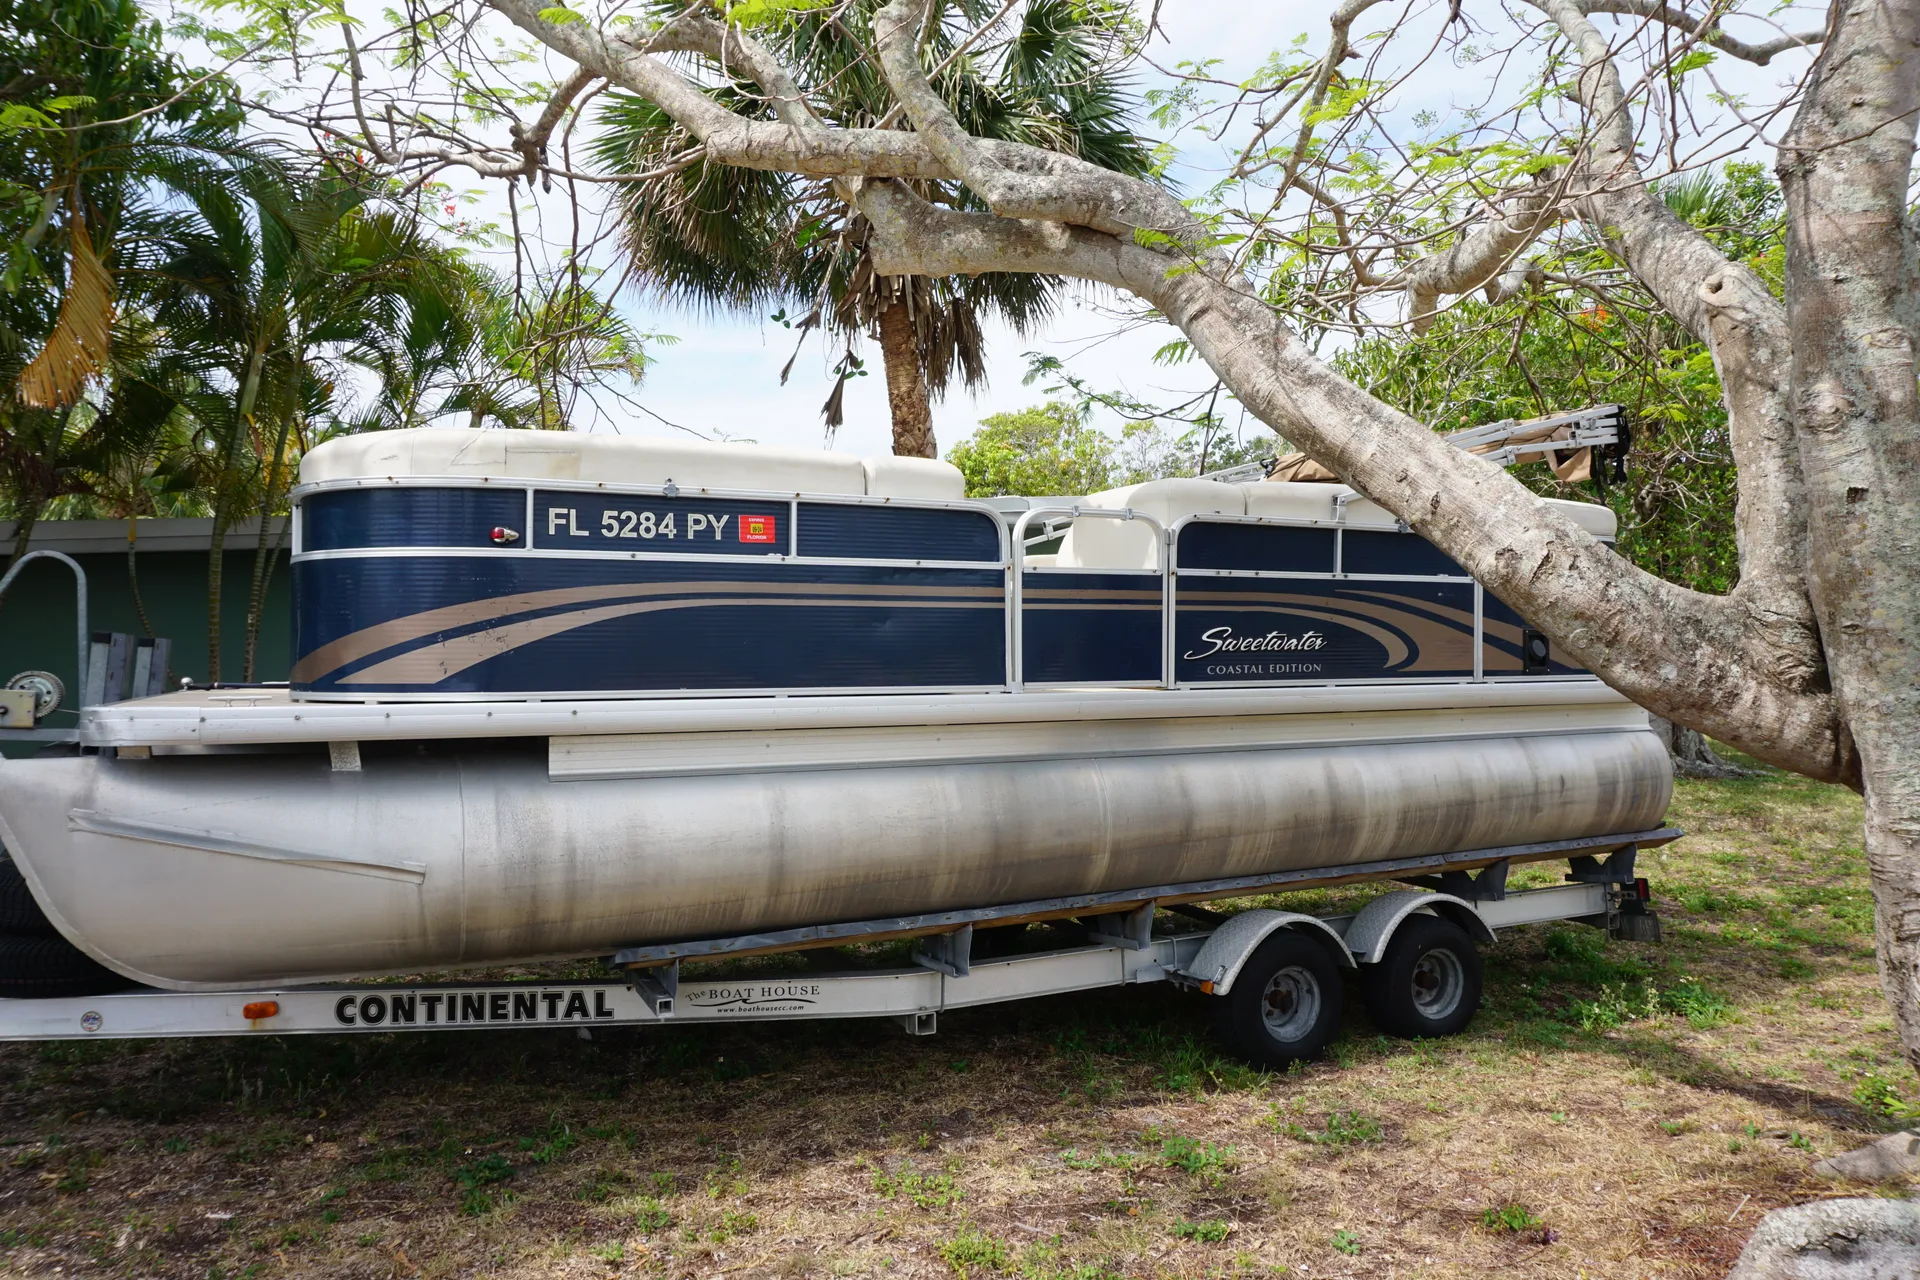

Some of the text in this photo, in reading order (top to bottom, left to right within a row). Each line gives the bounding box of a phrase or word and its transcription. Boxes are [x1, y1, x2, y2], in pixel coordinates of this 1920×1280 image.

[548, 507, 730, 540] FL 5284 PY
[1183, 626, 1328, 660] Sweetwater
[1207, 663, 1322, 675] COASTAL EDITION
[685, 985, 820, 1002] The BOAT HOUSE
[334, 989, 614, 1026] CONTINENTAL
[717, 1004, 805, 1013] www.boathousecc.com
